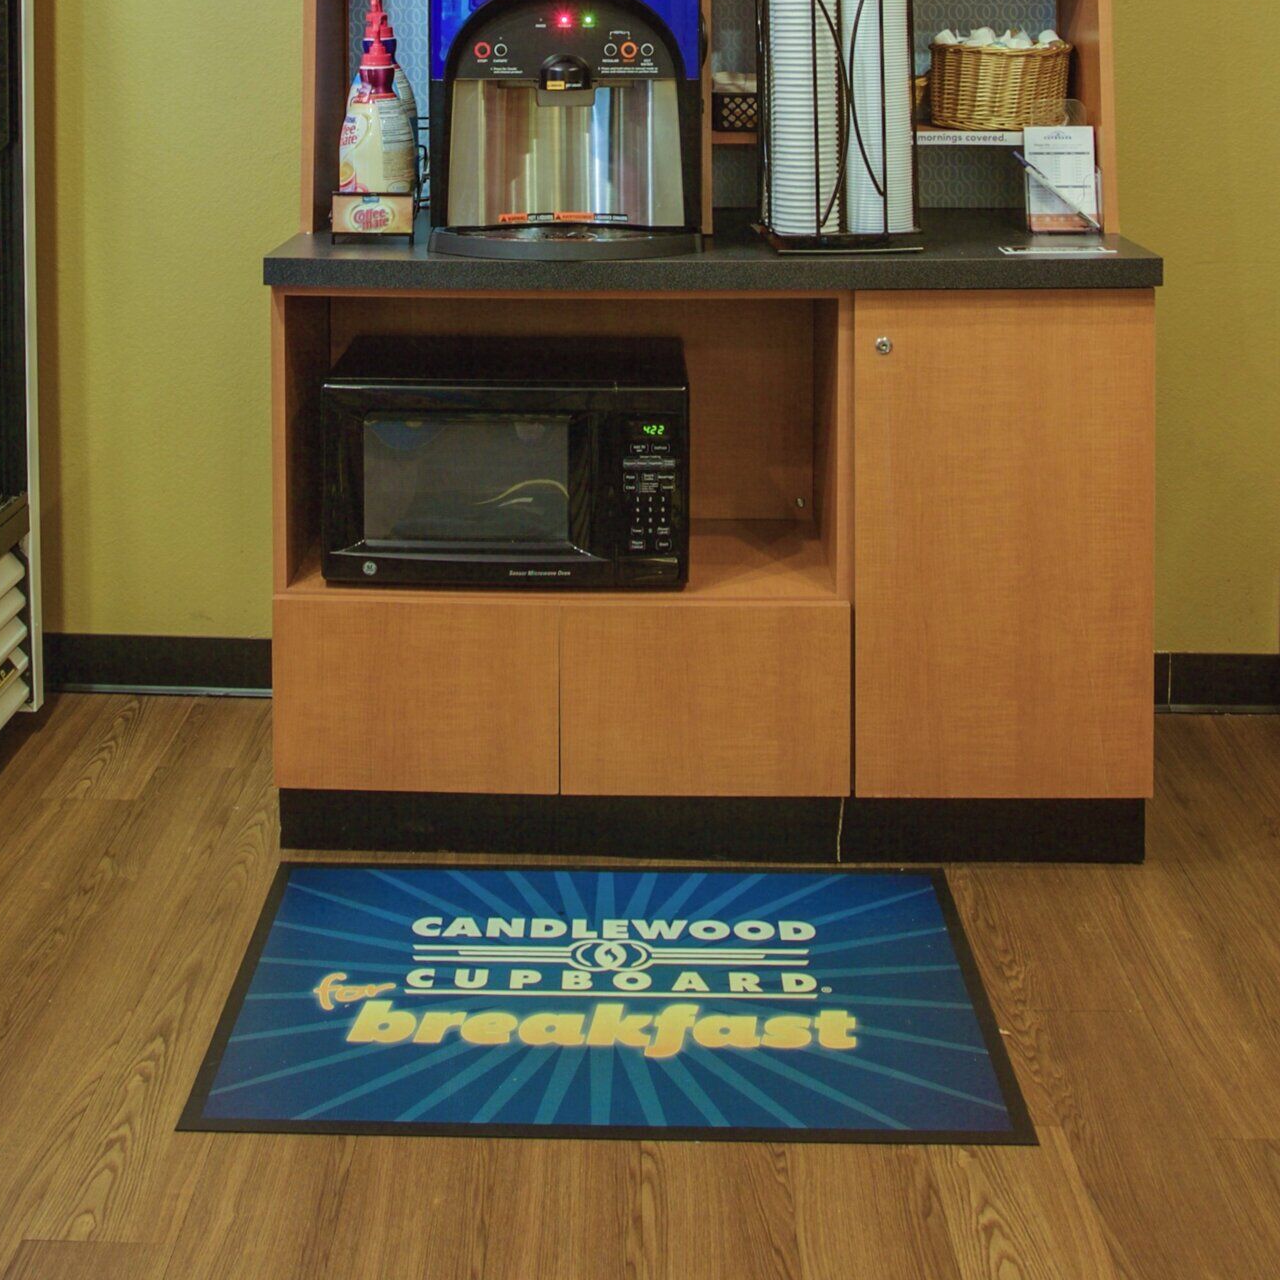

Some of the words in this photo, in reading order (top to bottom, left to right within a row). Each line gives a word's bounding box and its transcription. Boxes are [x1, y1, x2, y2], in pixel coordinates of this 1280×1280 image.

[917, 134, 963, 144] mornings
[964, 133, 1008, 143] covered.
[411, 916, 817, 942] CANDLEWOOD
[313, 972, 397, 1010] for
[405, 969, 819, 993] CUPBOARD
[345, 1000, 858, 1058] breakfast
